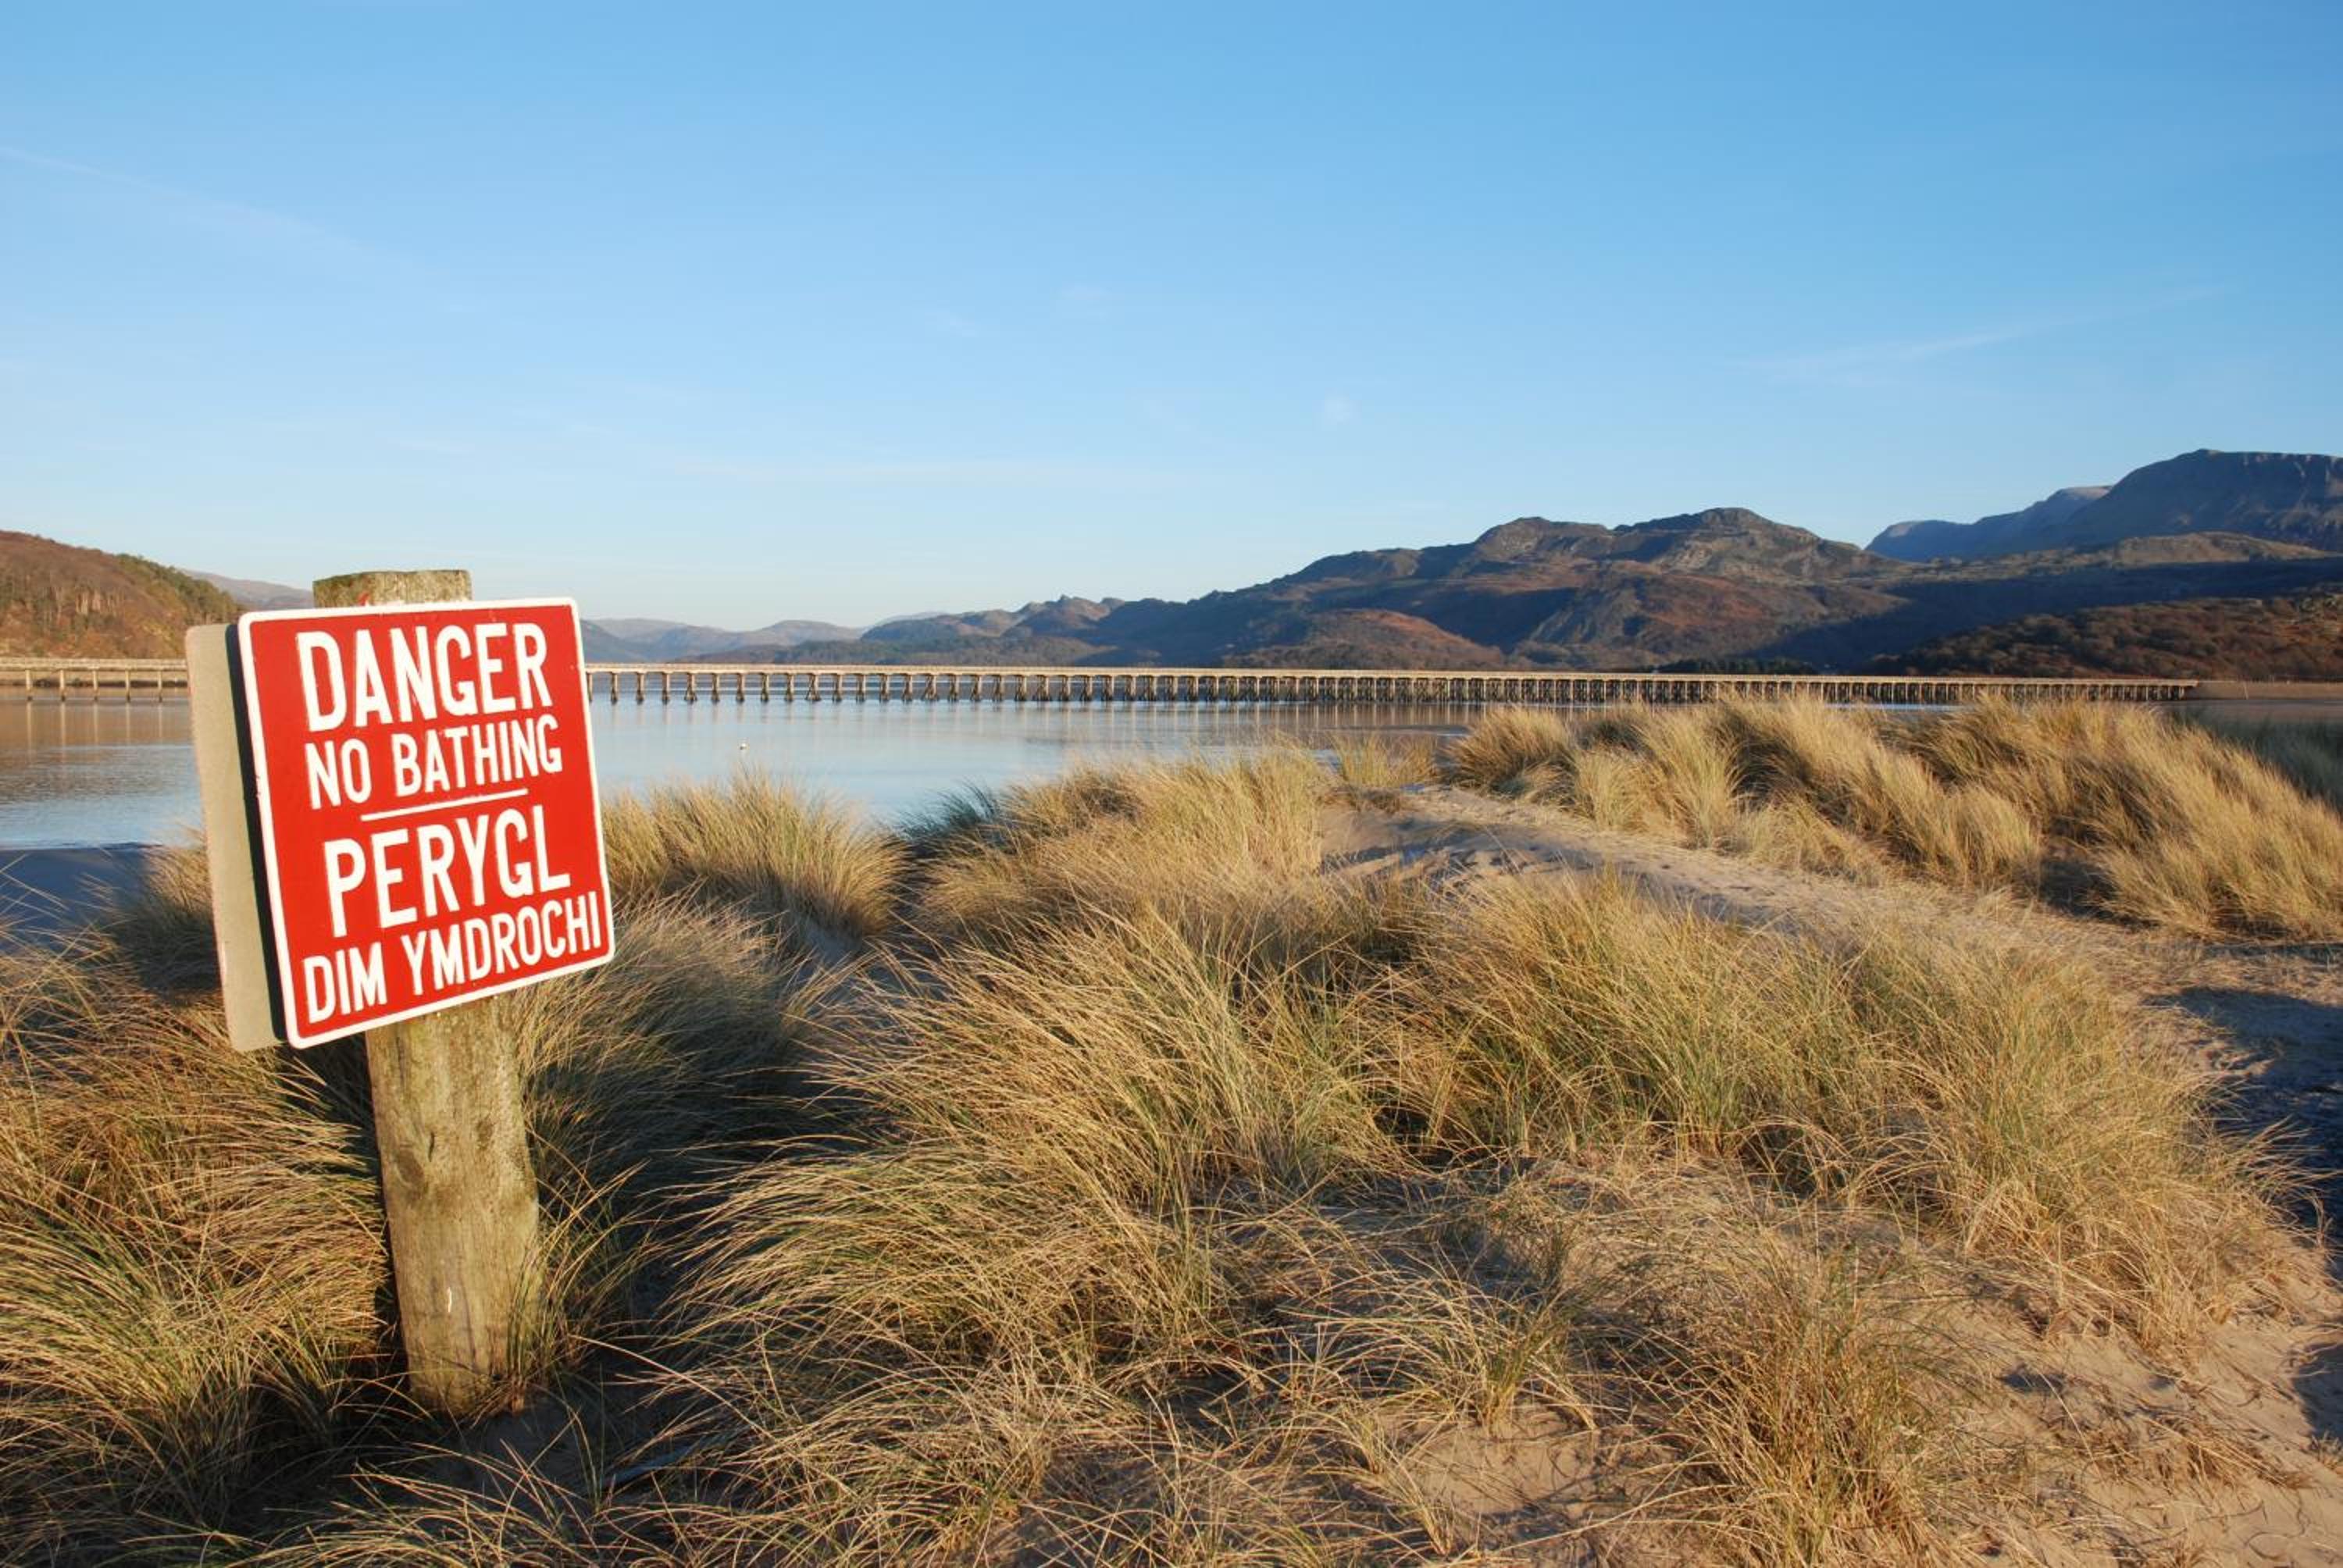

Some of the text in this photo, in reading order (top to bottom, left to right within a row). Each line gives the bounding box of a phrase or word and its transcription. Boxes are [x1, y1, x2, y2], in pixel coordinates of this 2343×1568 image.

[296, 622, 552, 732] DANGER
[305, 714, 563, 809] NO BATHING
[323, 805, 571, 939] PERYGL
[303, 891, 601, 1024] DIM YMDROCHI
